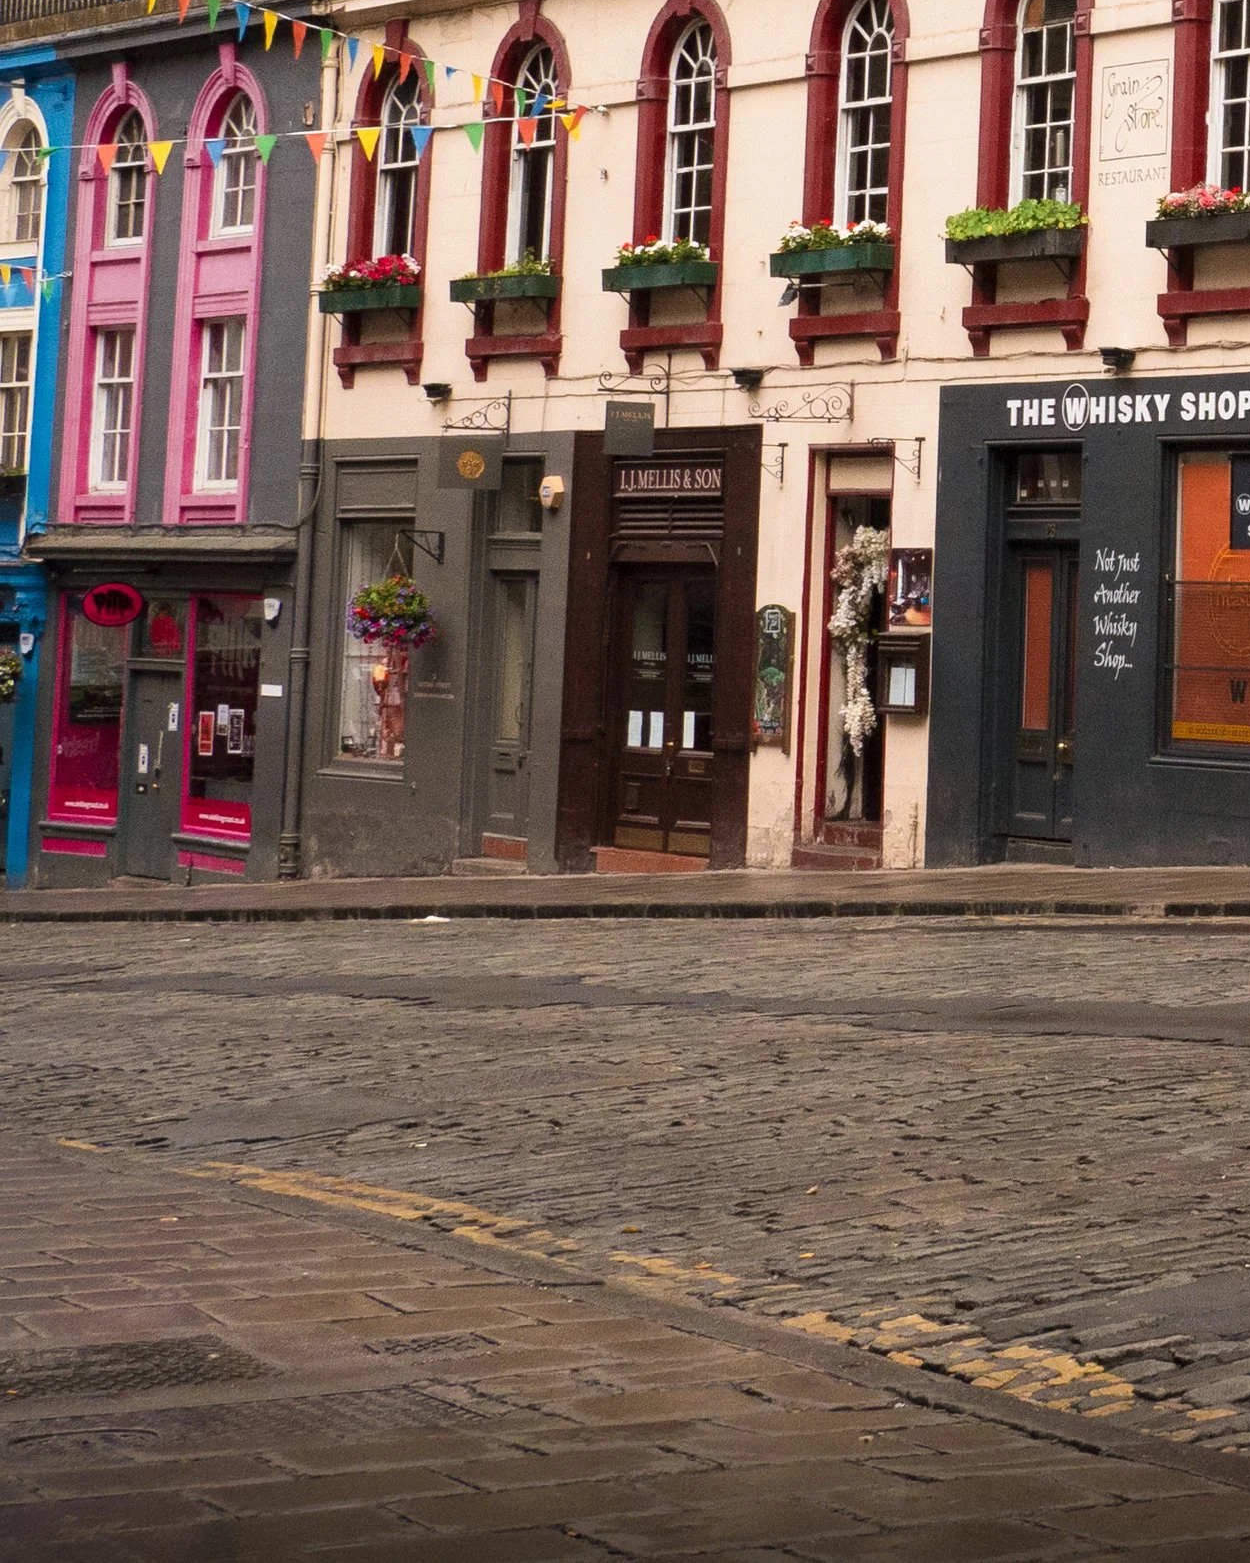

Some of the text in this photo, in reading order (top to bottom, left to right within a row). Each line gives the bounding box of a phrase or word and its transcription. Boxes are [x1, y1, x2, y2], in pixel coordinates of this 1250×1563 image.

[1097, 166, 1168, 187] RESTAURANT
[1006, 398, 1056, 426] THE
[1064, 393, 1171, 426] WHISKY
[683, 468, 692, 489] &
[694, 468, 722, 489] SON
[1094, 547, 1140, 582] Not Just
[1093, 582, 1141, 605] Another
[1093, 611, 1137, 647] Whisky
[1229, 678, 1248, 704] W
